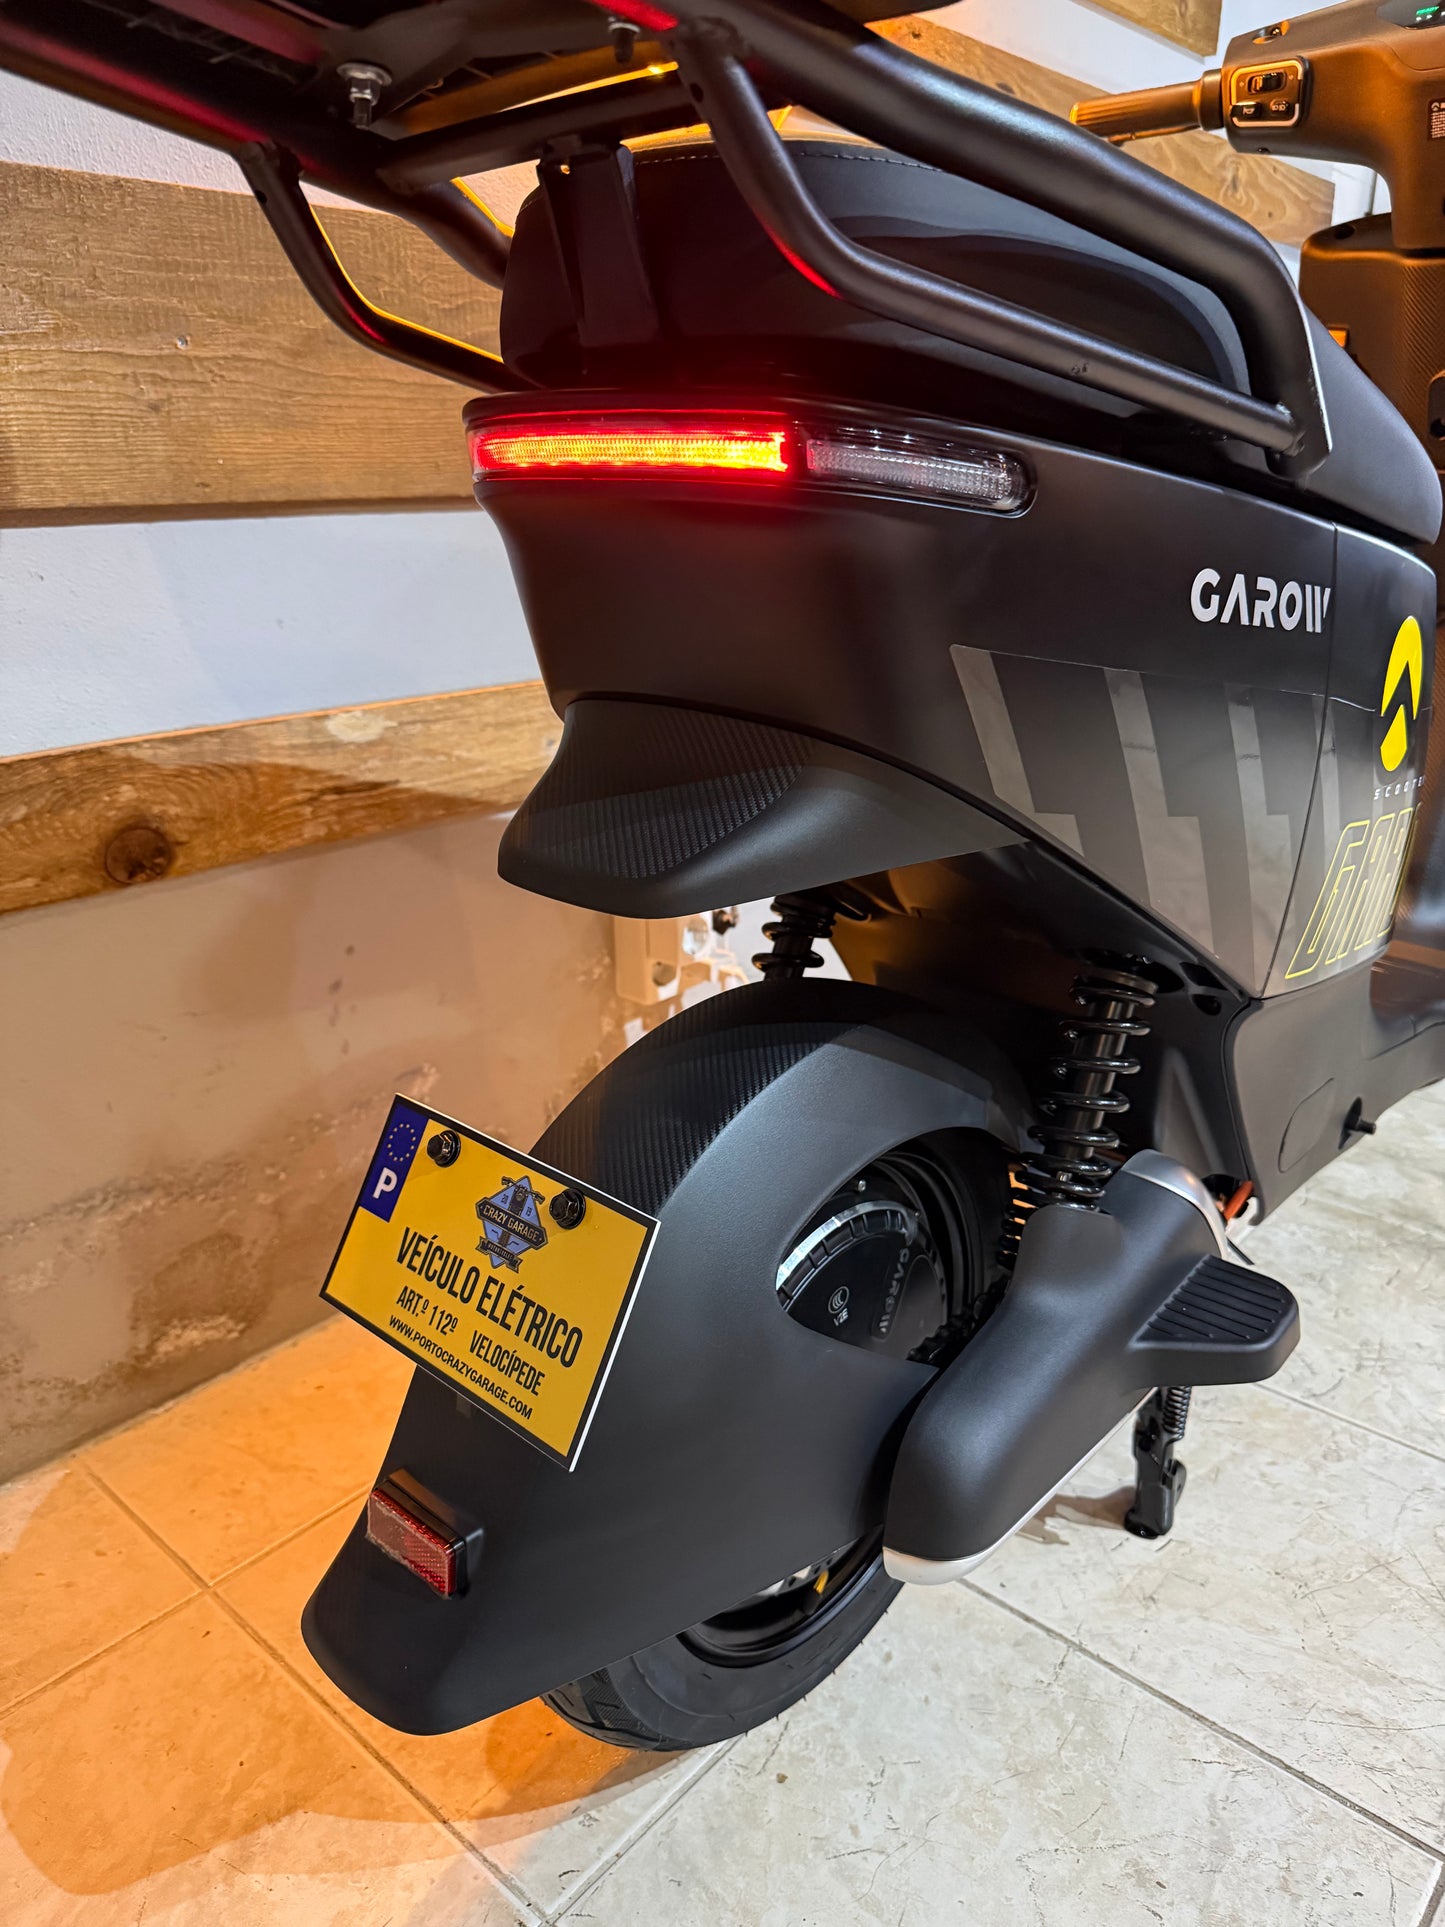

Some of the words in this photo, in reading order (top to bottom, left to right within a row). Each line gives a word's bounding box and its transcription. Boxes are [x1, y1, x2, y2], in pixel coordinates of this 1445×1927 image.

[1190, 567, 1332, 634] GAROW
[372, 1167, 398, 1199] P
[483, 1204, 508, 1225] CRAZY
[507, 1217, 540, 1242] GARAGE
[396, 1226, 480, 1304] VEÍCULO
[478, 1275, 583, 1367] ELÉTRICO
[389, 1315, 533, 1420] WWW.PORTOCRAZYGARAGE.COM
[469, 1330, 546, 1396] VELOCÍPEDE
